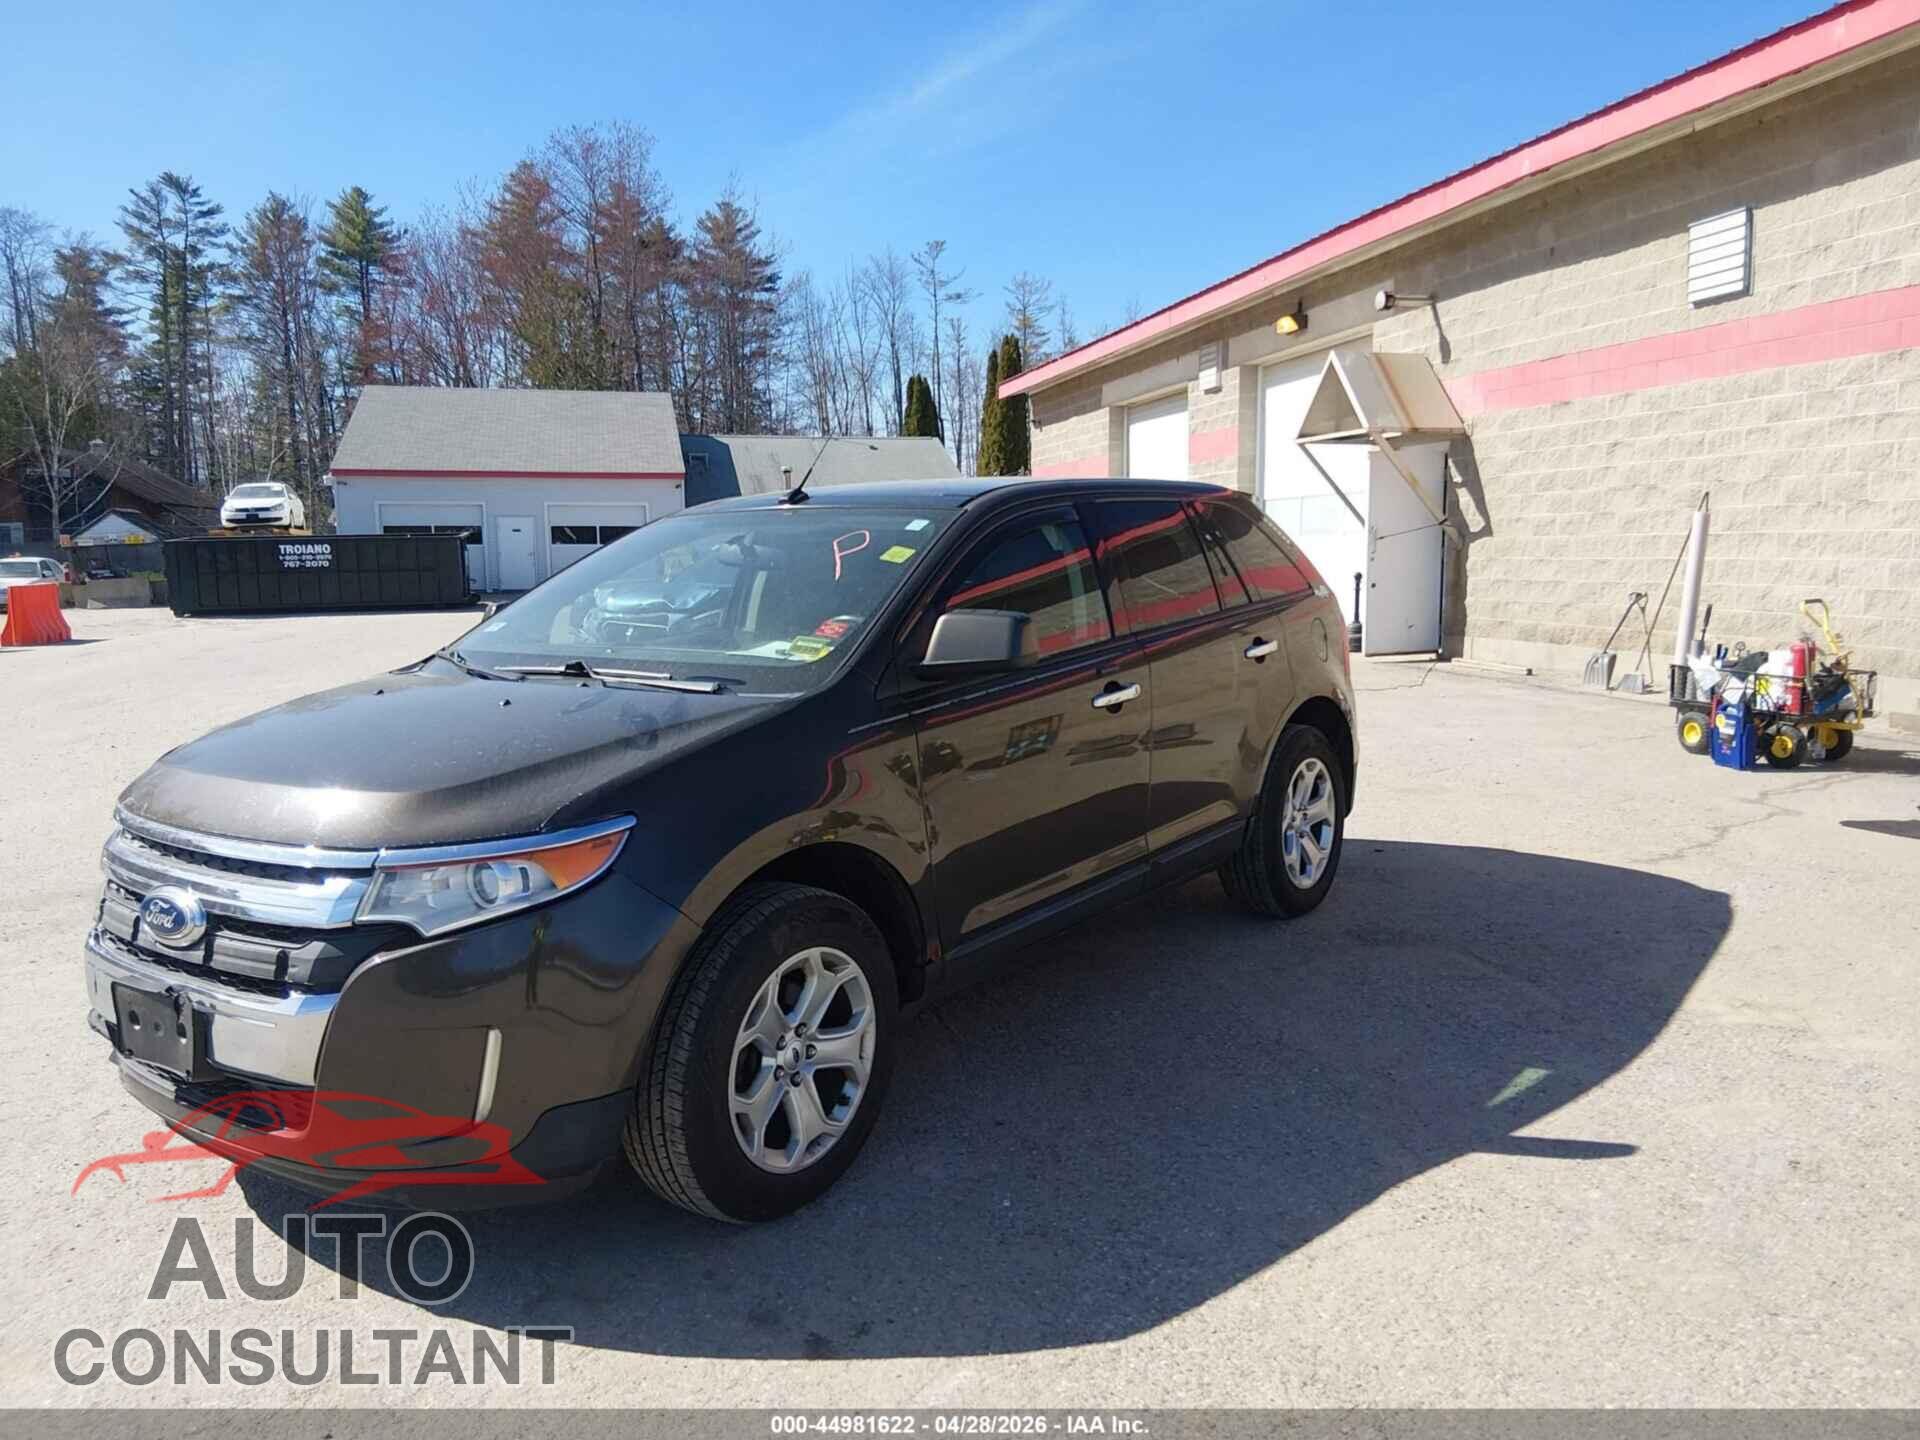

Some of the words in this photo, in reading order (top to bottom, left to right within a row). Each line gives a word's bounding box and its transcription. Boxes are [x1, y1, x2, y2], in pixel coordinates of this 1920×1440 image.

[278, 543, 332, 554] TROIANO
[832, 529, 871, 582] P
[145, 899, 178, 929] Ford
